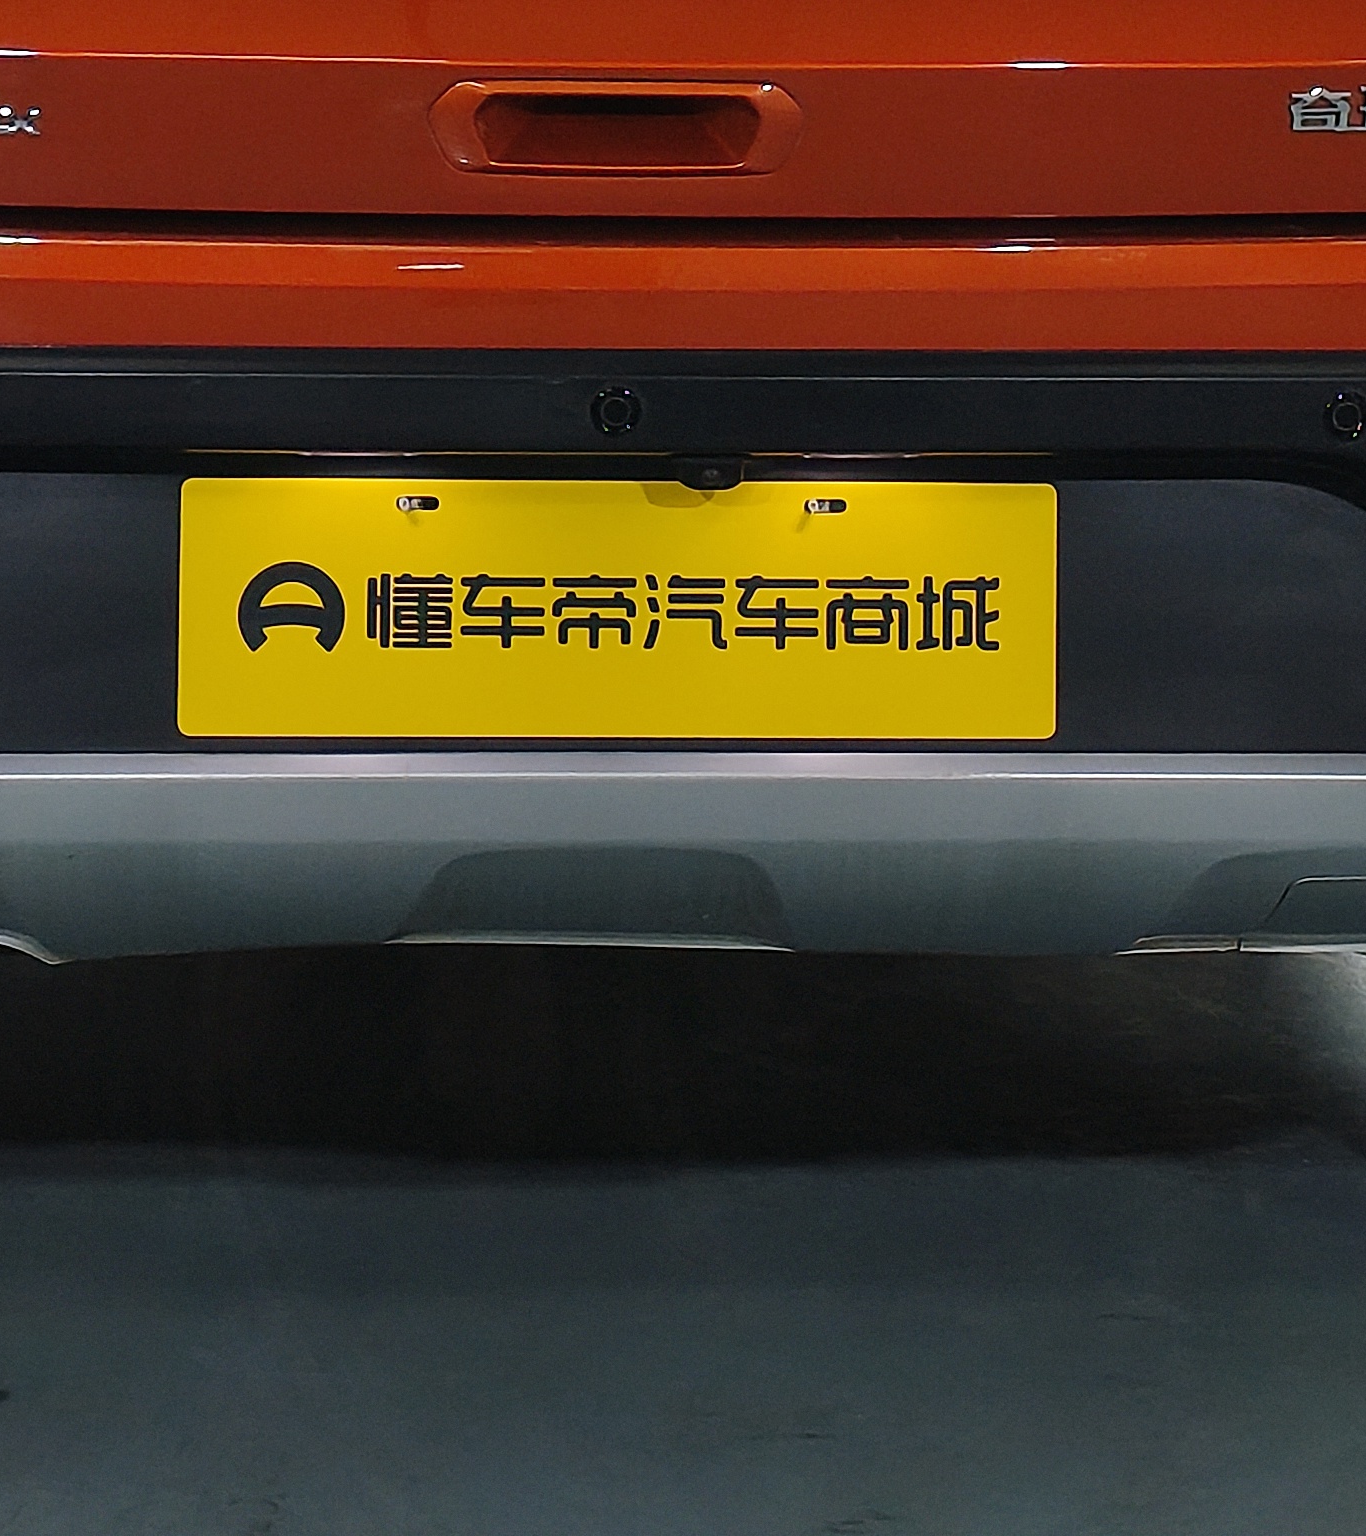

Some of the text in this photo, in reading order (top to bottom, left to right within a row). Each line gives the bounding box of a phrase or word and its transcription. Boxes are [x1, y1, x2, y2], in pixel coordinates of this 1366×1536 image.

[365, 573, 1001, 651] 懂车帝汽车商城
